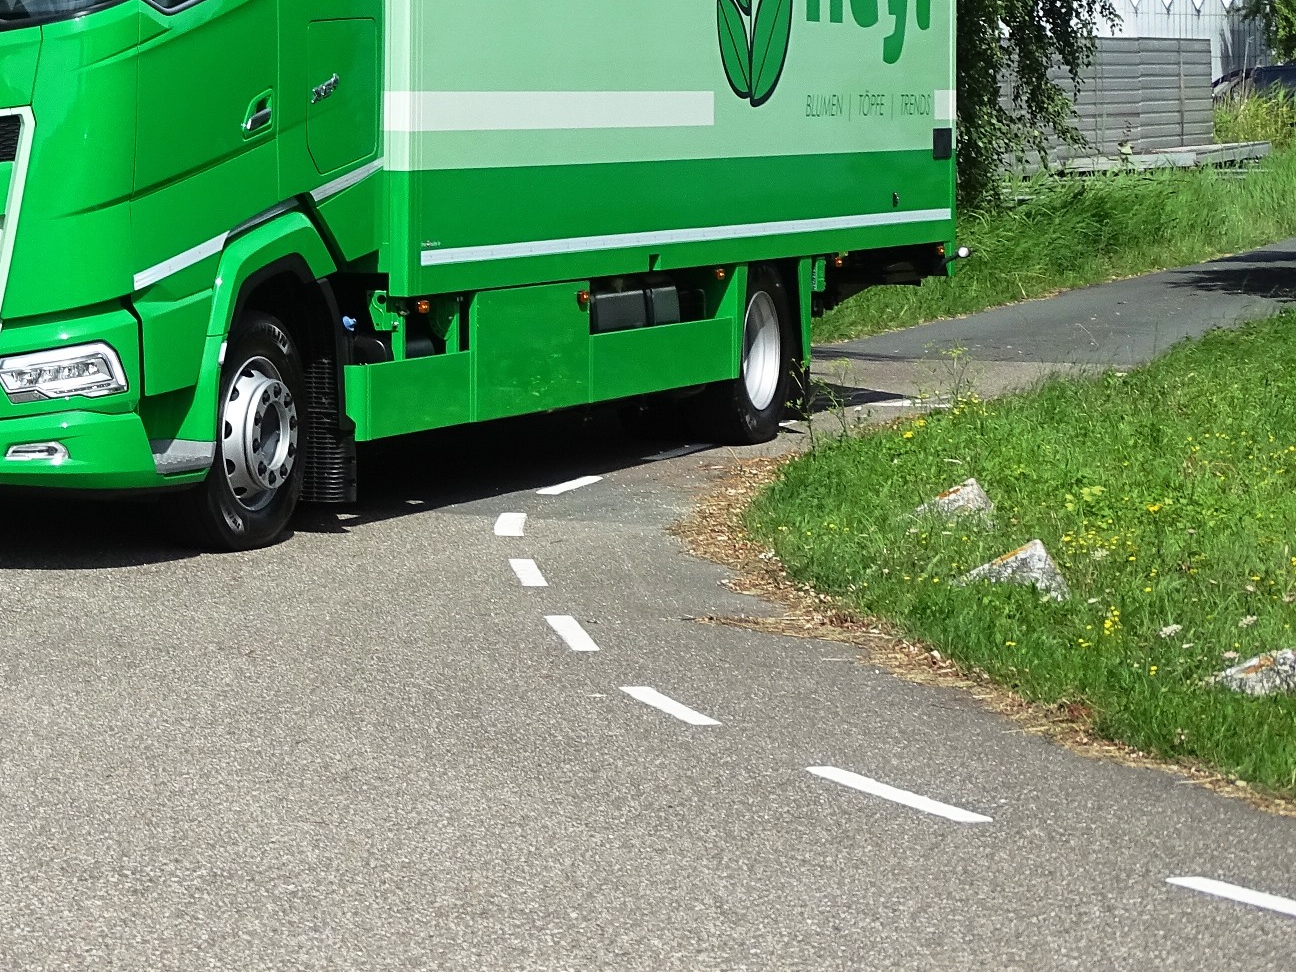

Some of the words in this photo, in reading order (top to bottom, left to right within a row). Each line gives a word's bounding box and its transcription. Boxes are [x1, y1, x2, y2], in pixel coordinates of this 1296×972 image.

[805, 94, 843, 117] BLUMEN
[858, 90, 886, 116] TÖPFE
[900, 94, 932, 116] TRENDS
